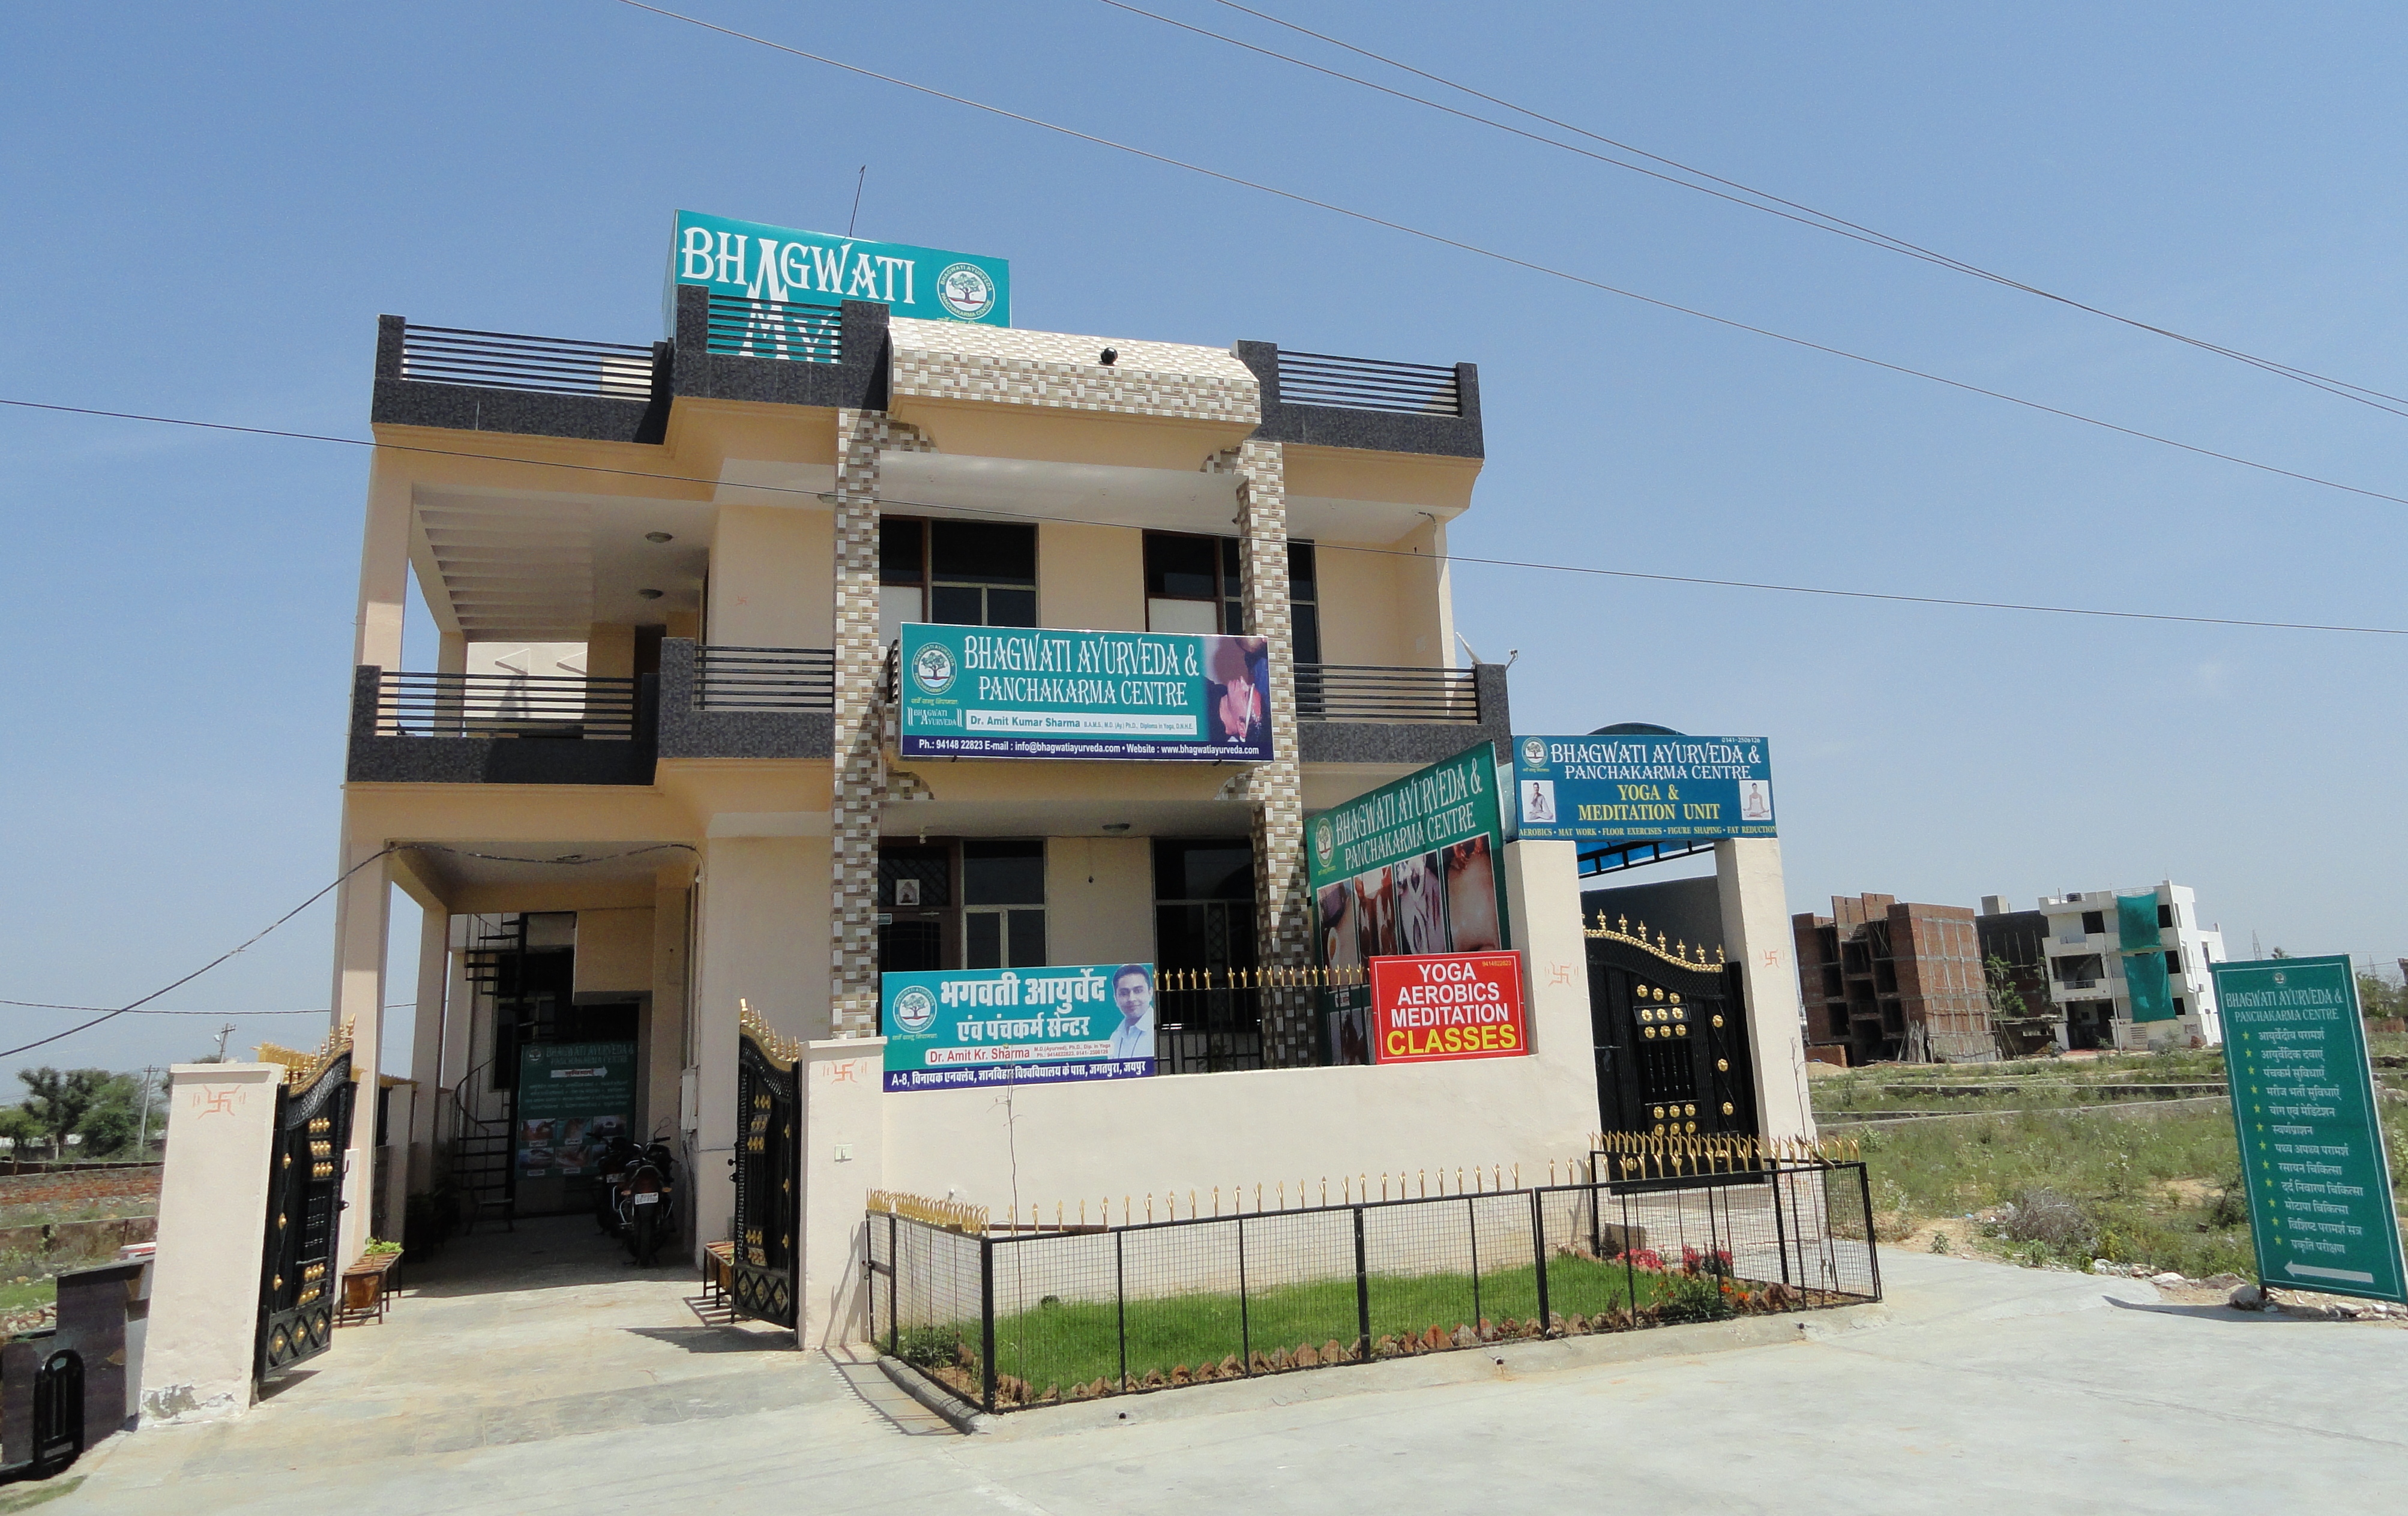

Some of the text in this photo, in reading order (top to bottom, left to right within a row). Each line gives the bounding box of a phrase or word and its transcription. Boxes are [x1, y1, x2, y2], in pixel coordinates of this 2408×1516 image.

[682, 227, 916, 304] BHAGWATI
[940, 265, 993, 292] BHAGWATI AYURVEDA
[941, 292, 992, 317] PANCHAKARMA CENTRE
[914, 645, 955, 667] BHAGWATI AYURVEDA
[964, 632, 1199, 677] BHAGWATI AYURVEDA &
[979, 676, 1188, 708] PANCHAKARMA CENTRE
[914, 709, 948, 717] BHAGWATI
[921, 715, 957, 726] AYURVEDA
[971, 715, 1080, 727] Dr. Amit Kumar Sharma
[919, 739, 935, 749] Ph.:
[936, 739, 959, 750] 94148
[960, 740, 983, 750] 22823
[985, 741, 1008, 751] E-mail
[1015, 742, 1121, 754] info@bhagwatiayurveda.com
[1127, 744, 1155, 753] Website
[1161, 745, 1259, 756] www.bhagwatiayurveda.com
[1550, 741, 1647, 763] BHAGWATI
[1652, 741, 1744, 765] AYURVEDA
[1748, 745, 1761, 764] &
[1564, 765, 1752, 780] PANCHAKARMA CENTRE
[1335, 793, 1395, 846] BHAGWATI
[1398, 763, 1468, 823] AYURVEDA
[1470, 757, 1482, 795] &
[1617, 784, 1679, 801] YOGA &
[1577, 804, 1720, 821] MEDITATION UNIT
[1345, 821, 1425, 871] PANCHAKARMA
[1427, 801, 1476, 843] CENTRE
[1418, 962, 1476, 982] YOGA
[941, 968, 1107, 1014] भगवती आयुर्वेद
[1397, 982, 1500, 1005] AEROBICS
[2226, 987, 2344, 1008] BHAGWATI AYURVEDA &
[1391, 1003, 1509, 1028] MEDITATION
[2234, 1008, 2340, 1023] PANCHAKARMA CENTRE
[986, 1012, 1044, 1040] पंचकर्म
[1047, 1012, 1090, 1037] सेन्टर
[2298, 1027, 2325, 1040] परामर्श
[1387, 1024, 1516, 1055] CLASSES
[930, 1048, 1029, 1063] Dr. Amit Kr. Sharma
[2261, 1047, 2325, 1063] आयुर्वेदिक दवाएं
[891, 1073, 910, 1087] A-8,
[912, 1071, 943, 1084] विनायक
[944, 1068, 977, 1083] एनक्लेव,
[1062, 1063, 1070, 1076] के
[1071, 1064, 1088, 1077] पास,
[1089, 1063, 1122, 1077] जगतपुरा,
[1124, 1061, 1146, 1075] जयपुर
[2263, 1065, 2290, 1078] पंचकर्म
[2265, 1084, 2287, 1096] मरीज
[2289, 1084, 2305, 1096] भर्ती
[2268, 1102, 2336, 1120] योग एवं मेडिटेशन
[2320, 1143, 2349, 1157] परामर्श
[2278, 1161, 2343, 1176] रसायन चिकित्सा
[2281, 1178, 2364, 1196] दर्द निवारण चिकित्सा
[2284, 1197, 2349, 1215] मोटापा चिकित्सा
[2287, 1217, 2362, 1236] विशिष्ट परामर्श सत्र
[2316, 1239, 2346, 1254] परीक्षण
